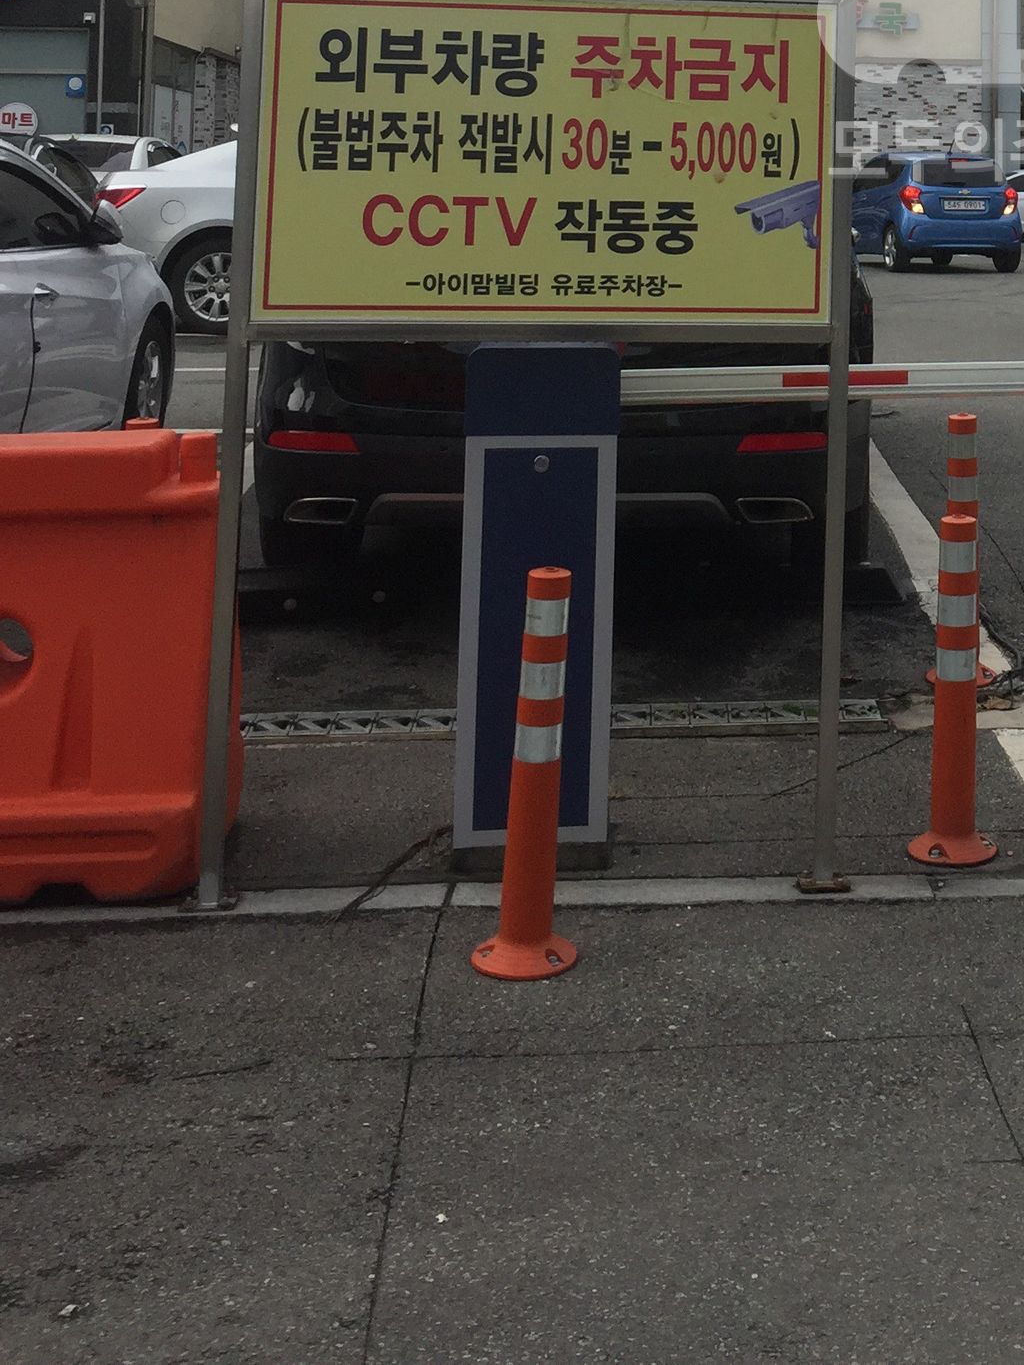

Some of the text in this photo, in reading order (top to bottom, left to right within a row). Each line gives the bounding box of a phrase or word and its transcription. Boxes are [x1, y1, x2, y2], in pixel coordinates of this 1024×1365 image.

[315, 27, 790, 103] 외부차량 주차금지
[2, 112, 34, 129] 마트
[298, 107, 443, 173] (불법주차
[362, 194, 699, 255] CCTV 작동중
